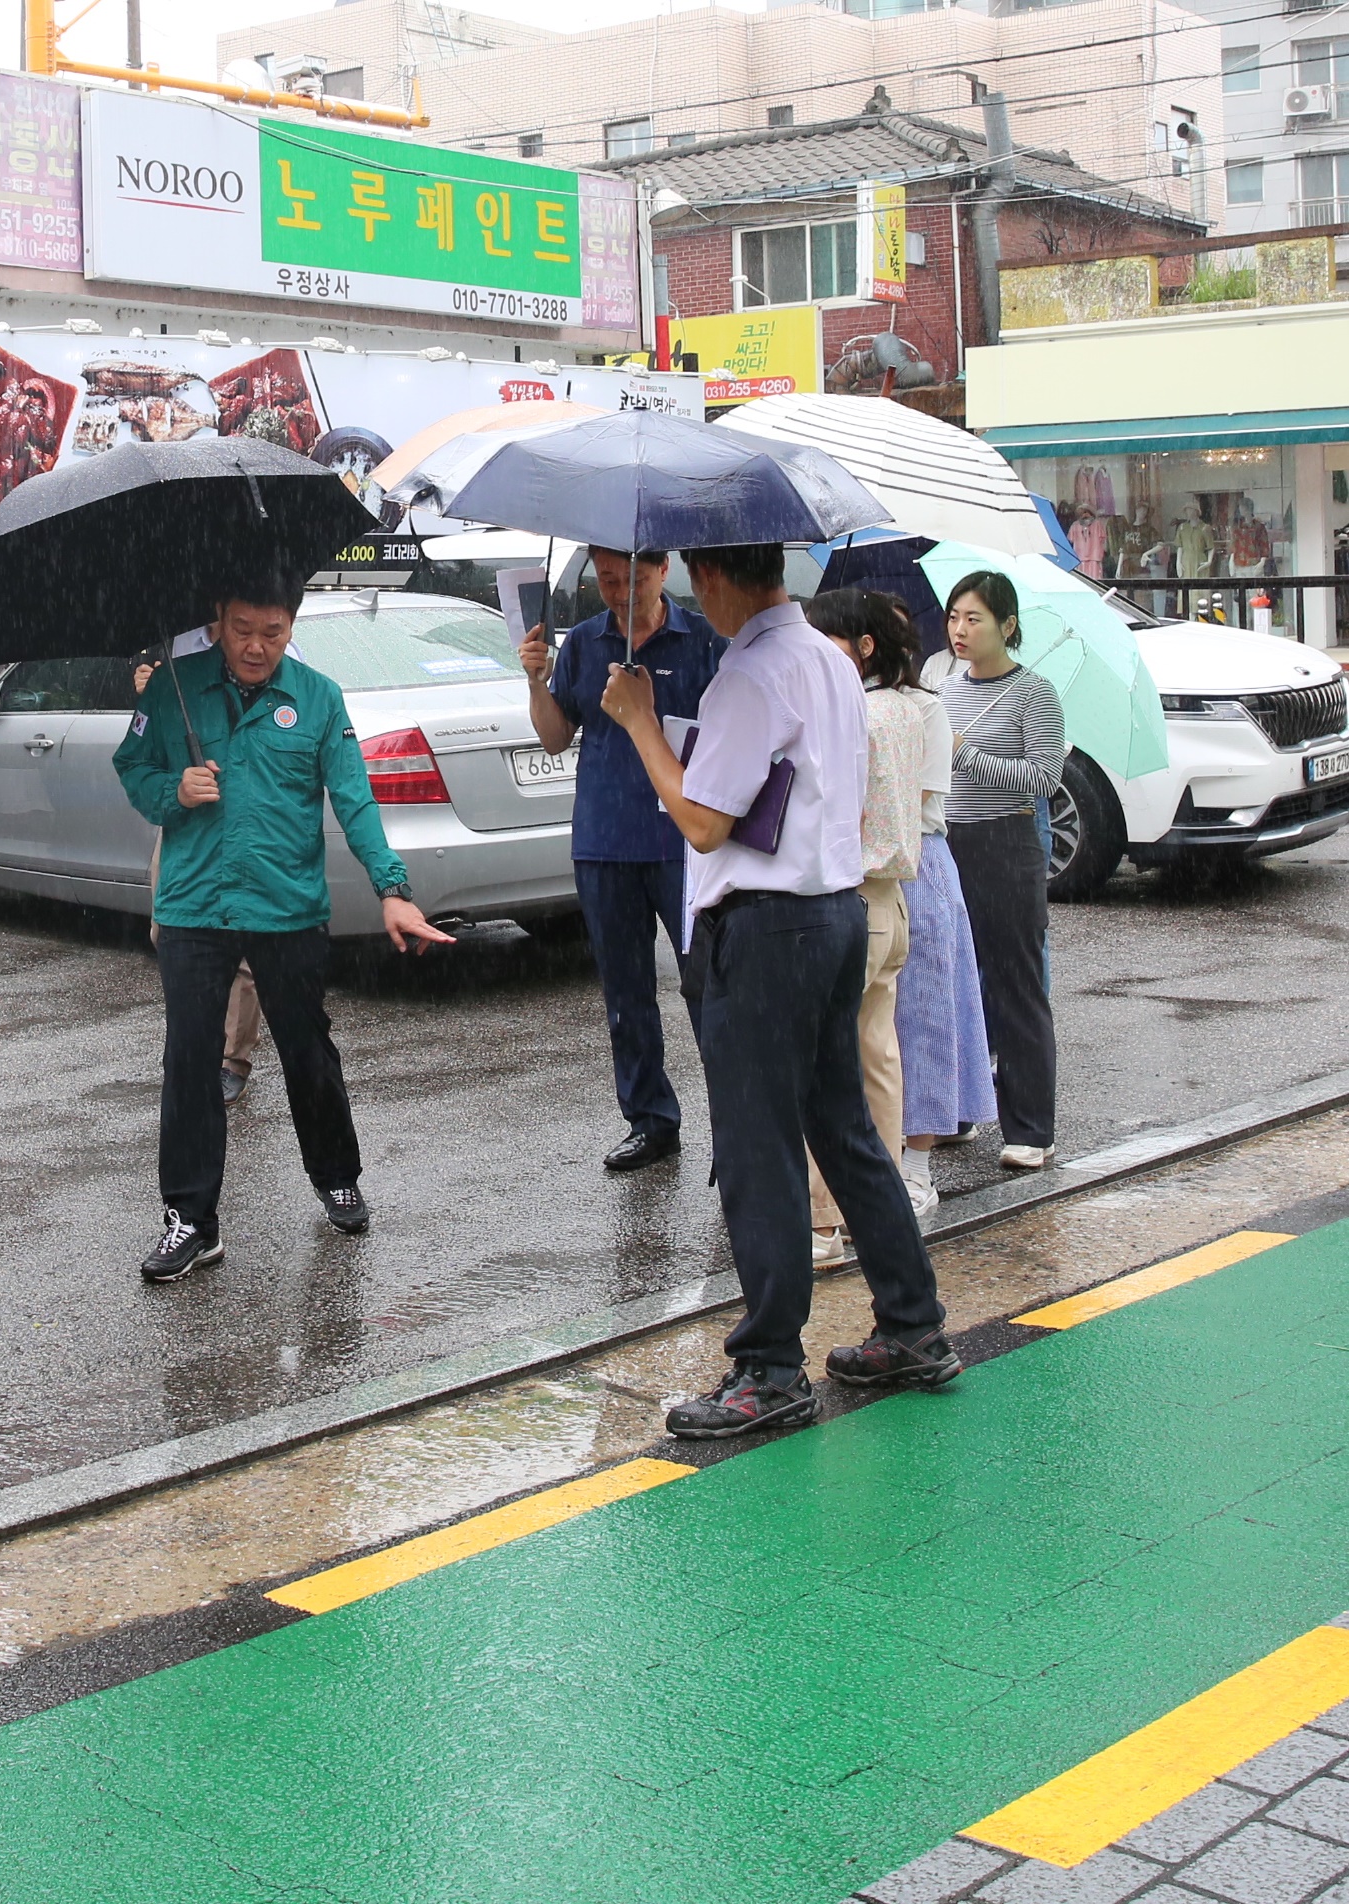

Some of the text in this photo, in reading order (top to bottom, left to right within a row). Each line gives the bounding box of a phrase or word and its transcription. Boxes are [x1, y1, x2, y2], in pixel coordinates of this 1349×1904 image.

[115, 154, 244, 203] NOROO
[276, 158, 572, 264] 노루페인트
[276, 268, 351, 300] 우정상사
[452, 287, 569, 322] 010-7701-3288
[740, 321, 776, 338] 크고!
[735, 339, 769, 357] 싸고!
[706, 378, 791, 399] 031) 255-4260
[434, 724, 489, 738] CHAIRMAN
